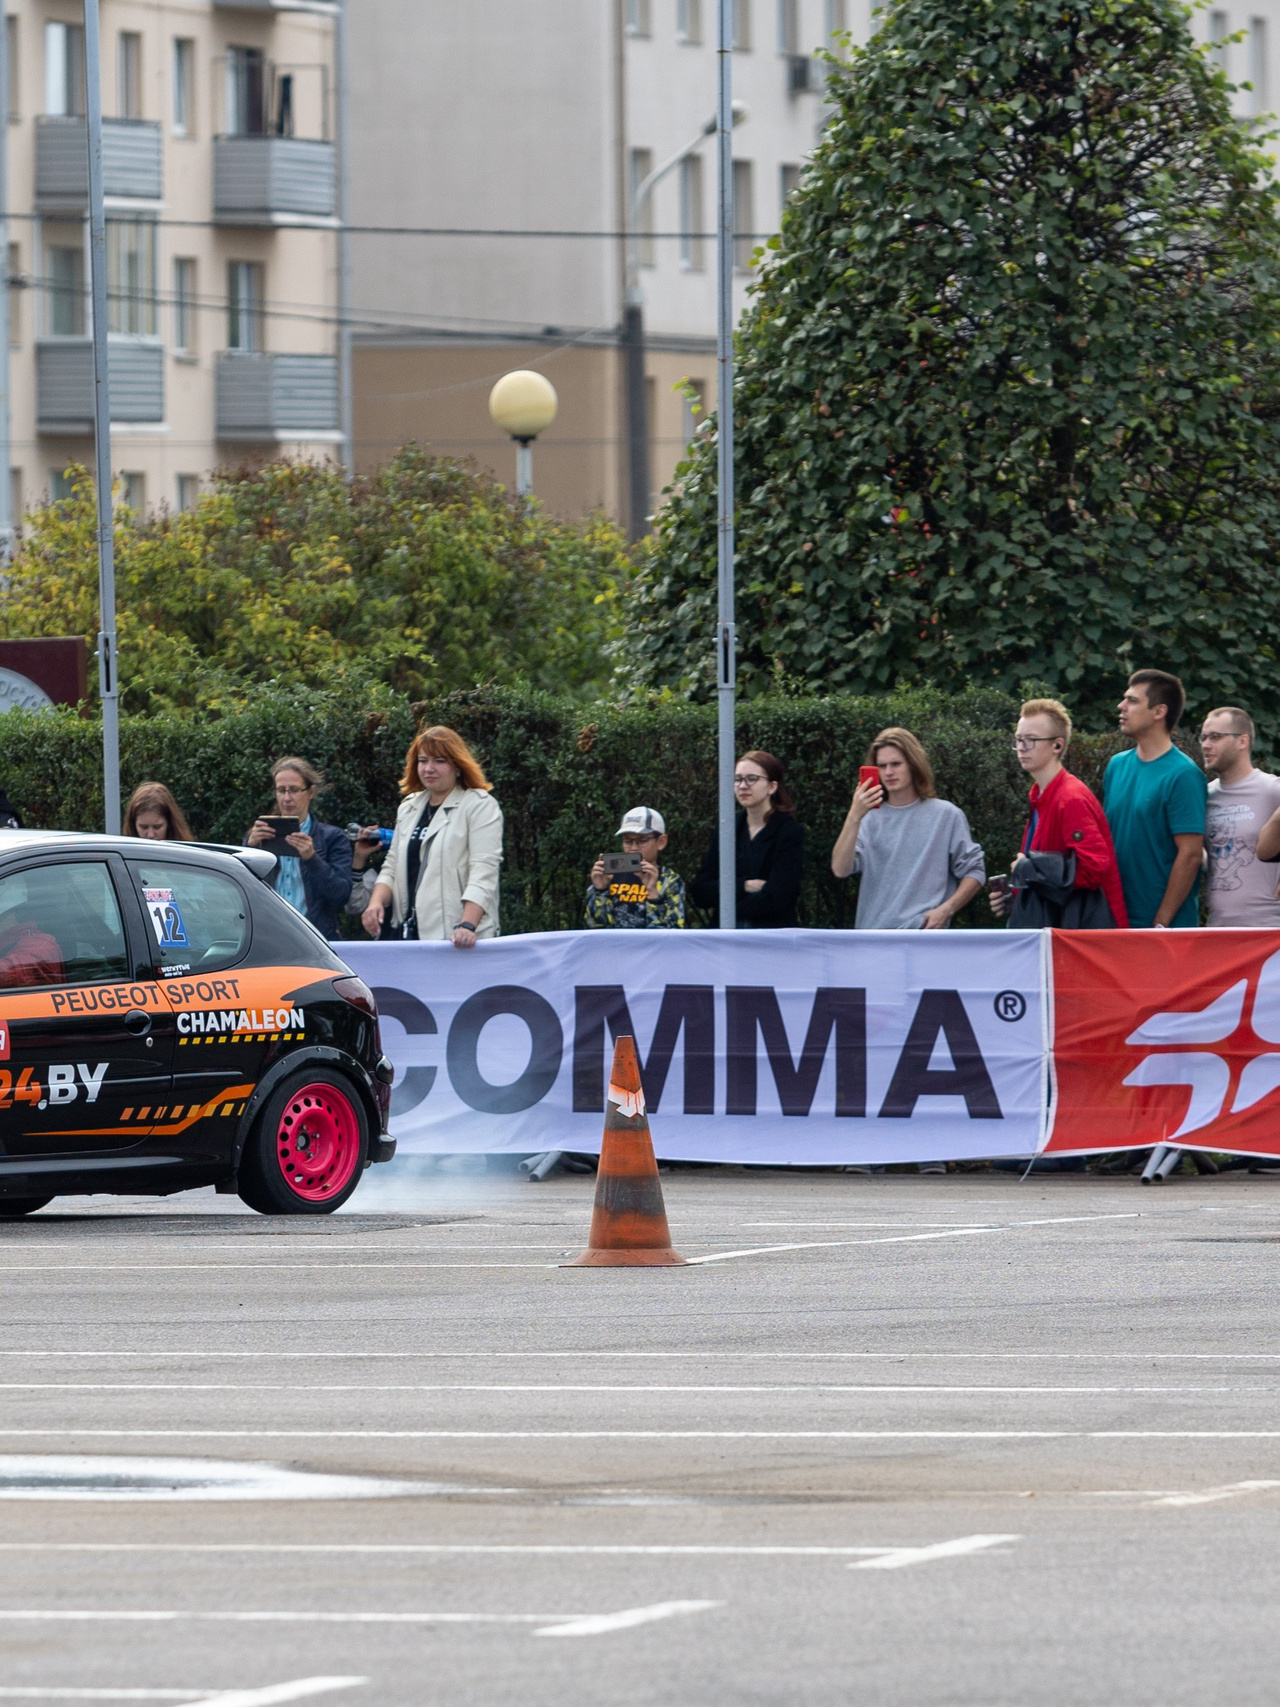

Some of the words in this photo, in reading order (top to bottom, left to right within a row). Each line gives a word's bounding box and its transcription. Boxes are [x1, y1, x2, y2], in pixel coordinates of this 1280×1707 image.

[152, 905, 186, 942] 12
[50, 984, 160, 1014] PEUGEOT
[166, 978, 241, 1005] SPORT
